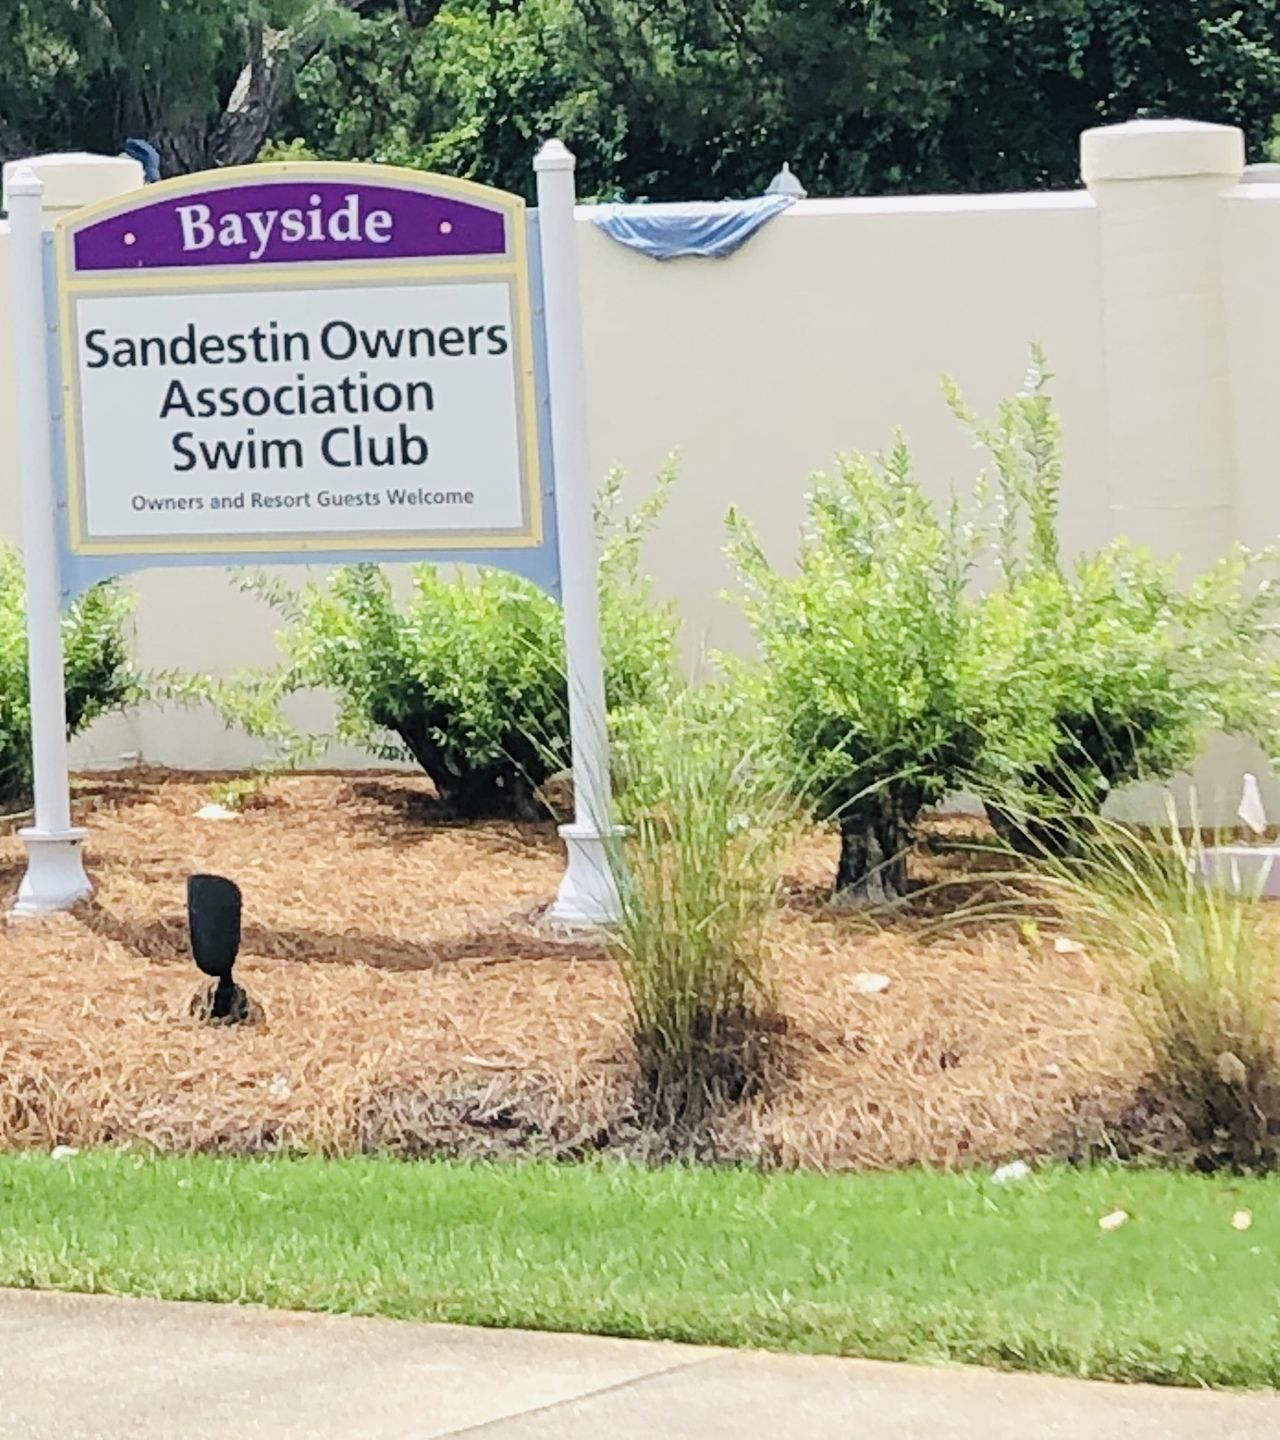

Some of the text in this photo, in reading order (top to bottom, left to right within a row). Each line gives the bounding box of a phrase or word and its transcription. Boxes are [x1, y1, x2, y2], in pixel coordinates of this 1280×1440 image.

[175, 194, 394, 259] Bayside
[85, 320, 508, 369] Sandestin Owners
[159, 371, 434, 419] Association
[171, 422, 429, 472] Swim Club
[131, 487, 475, 512] Owners and Resort Guests Welcome
